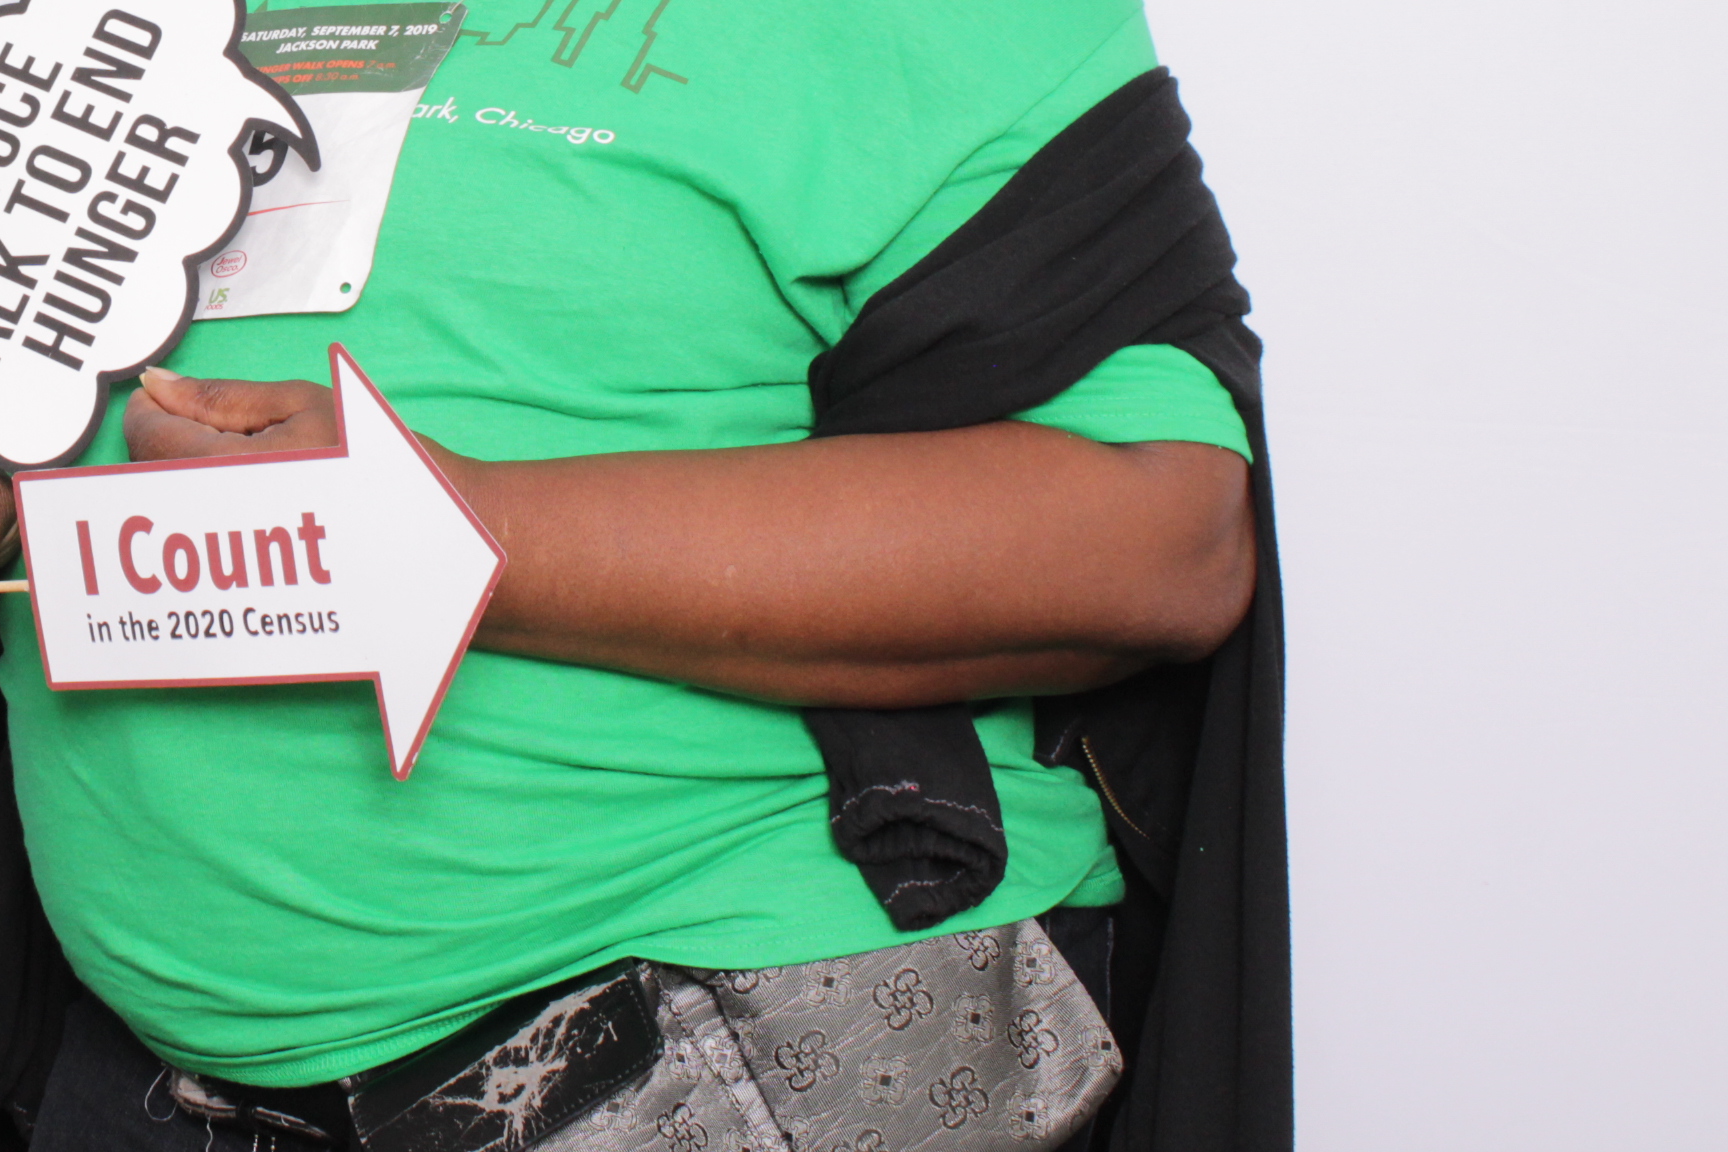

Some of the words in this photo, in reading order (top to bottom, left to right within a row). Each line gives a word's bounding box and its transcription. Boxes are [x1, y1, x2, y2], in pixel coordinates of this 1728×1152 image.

[276, 40, 340, 54] JACKSON
[340, 39, 380, 50] PARK
[311, 24, 386, 37] SEPTEMBER
[385, 24, 400, 38] 7,
[403, 23, 438, 36] 2019
[292, 60, 326, 71] WALK
[325, 59, 366, 69] OPENS
[3, 144, 93, 225] TO
[50, 8, 163, 143] END
[411, 97, 460, 124] ark,
[474, 106, 616, 145] Chicago
[21, 112, 202, 372] HUNGER
[75, 519, 100, 597] I
[117, 511, 333, 595] Count
[86, 612, 113, 644] in
[118, 611, 161, 643] the
[169, 608, 235, 641] 2020
[242, 606, 341, 638] Census
